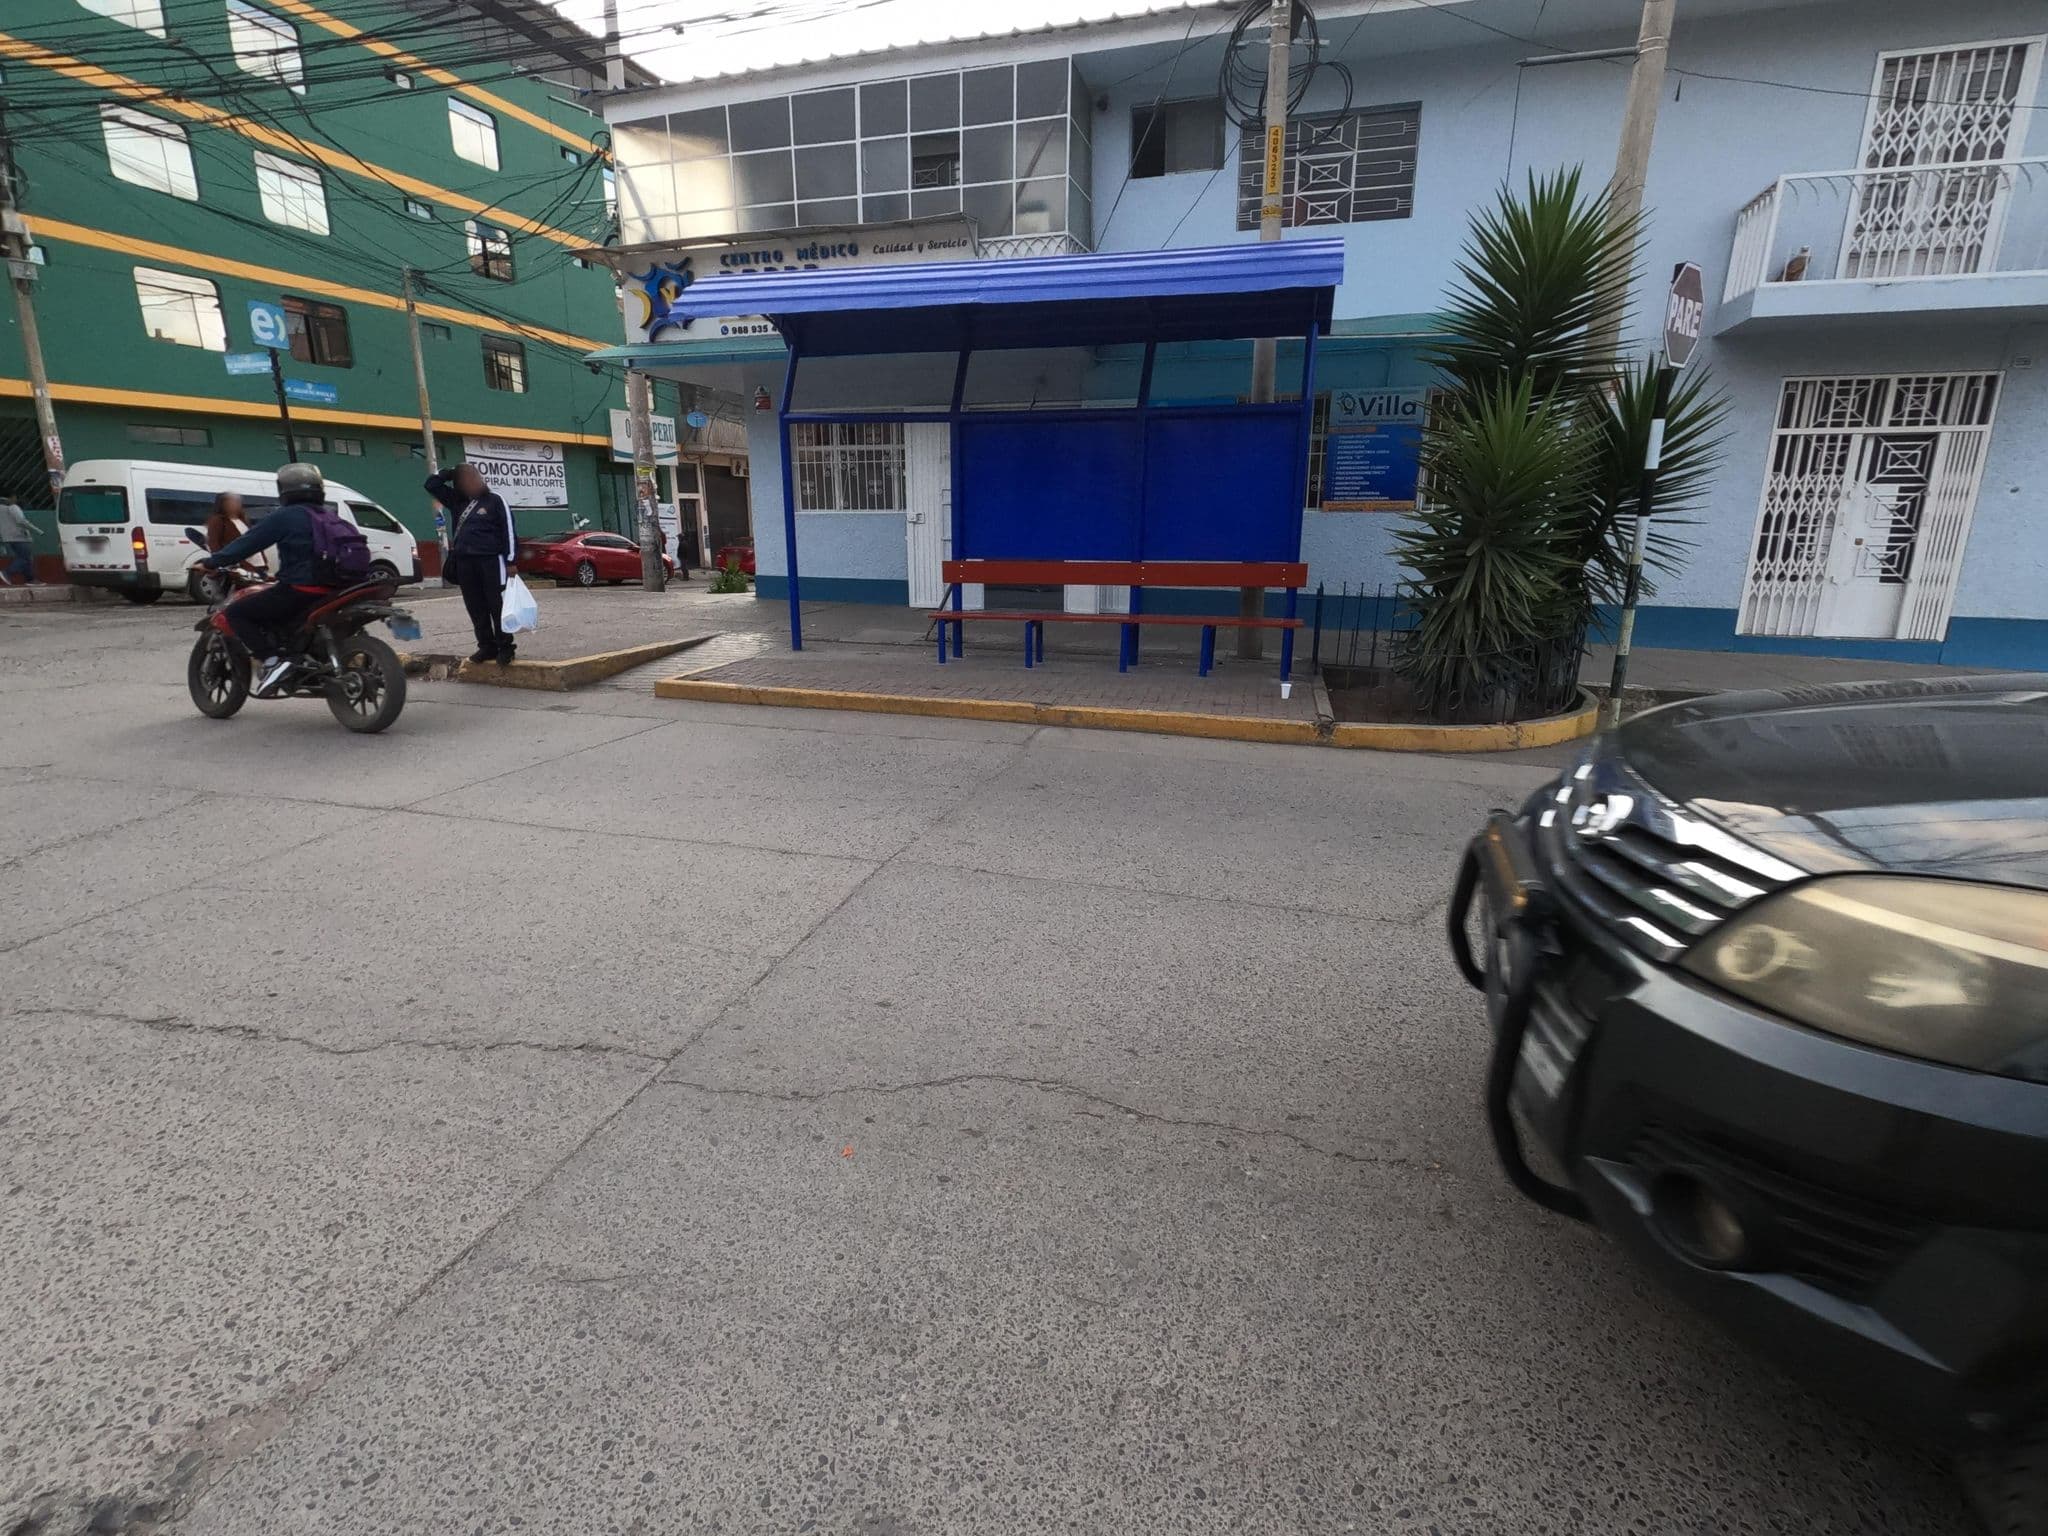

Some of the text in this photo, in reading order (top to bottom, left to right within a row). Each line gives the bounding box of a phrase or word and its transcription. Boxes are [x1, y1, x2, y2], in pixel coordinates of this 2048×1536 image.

[720, 242, 859, 267] CENTRO MÉDICO
[872, 243, 914, 255] Calidad
[927, 238, 968, 250] Servicio
[1667, 293, 1703, 337] PARE
[751, 324, 769, 334] 935
[1358, 394, 1417, 416] Villa
[469, 461, 564, 478] TOMOGRAFIAS
[513, 477, 565, 489] MULTICORTE
